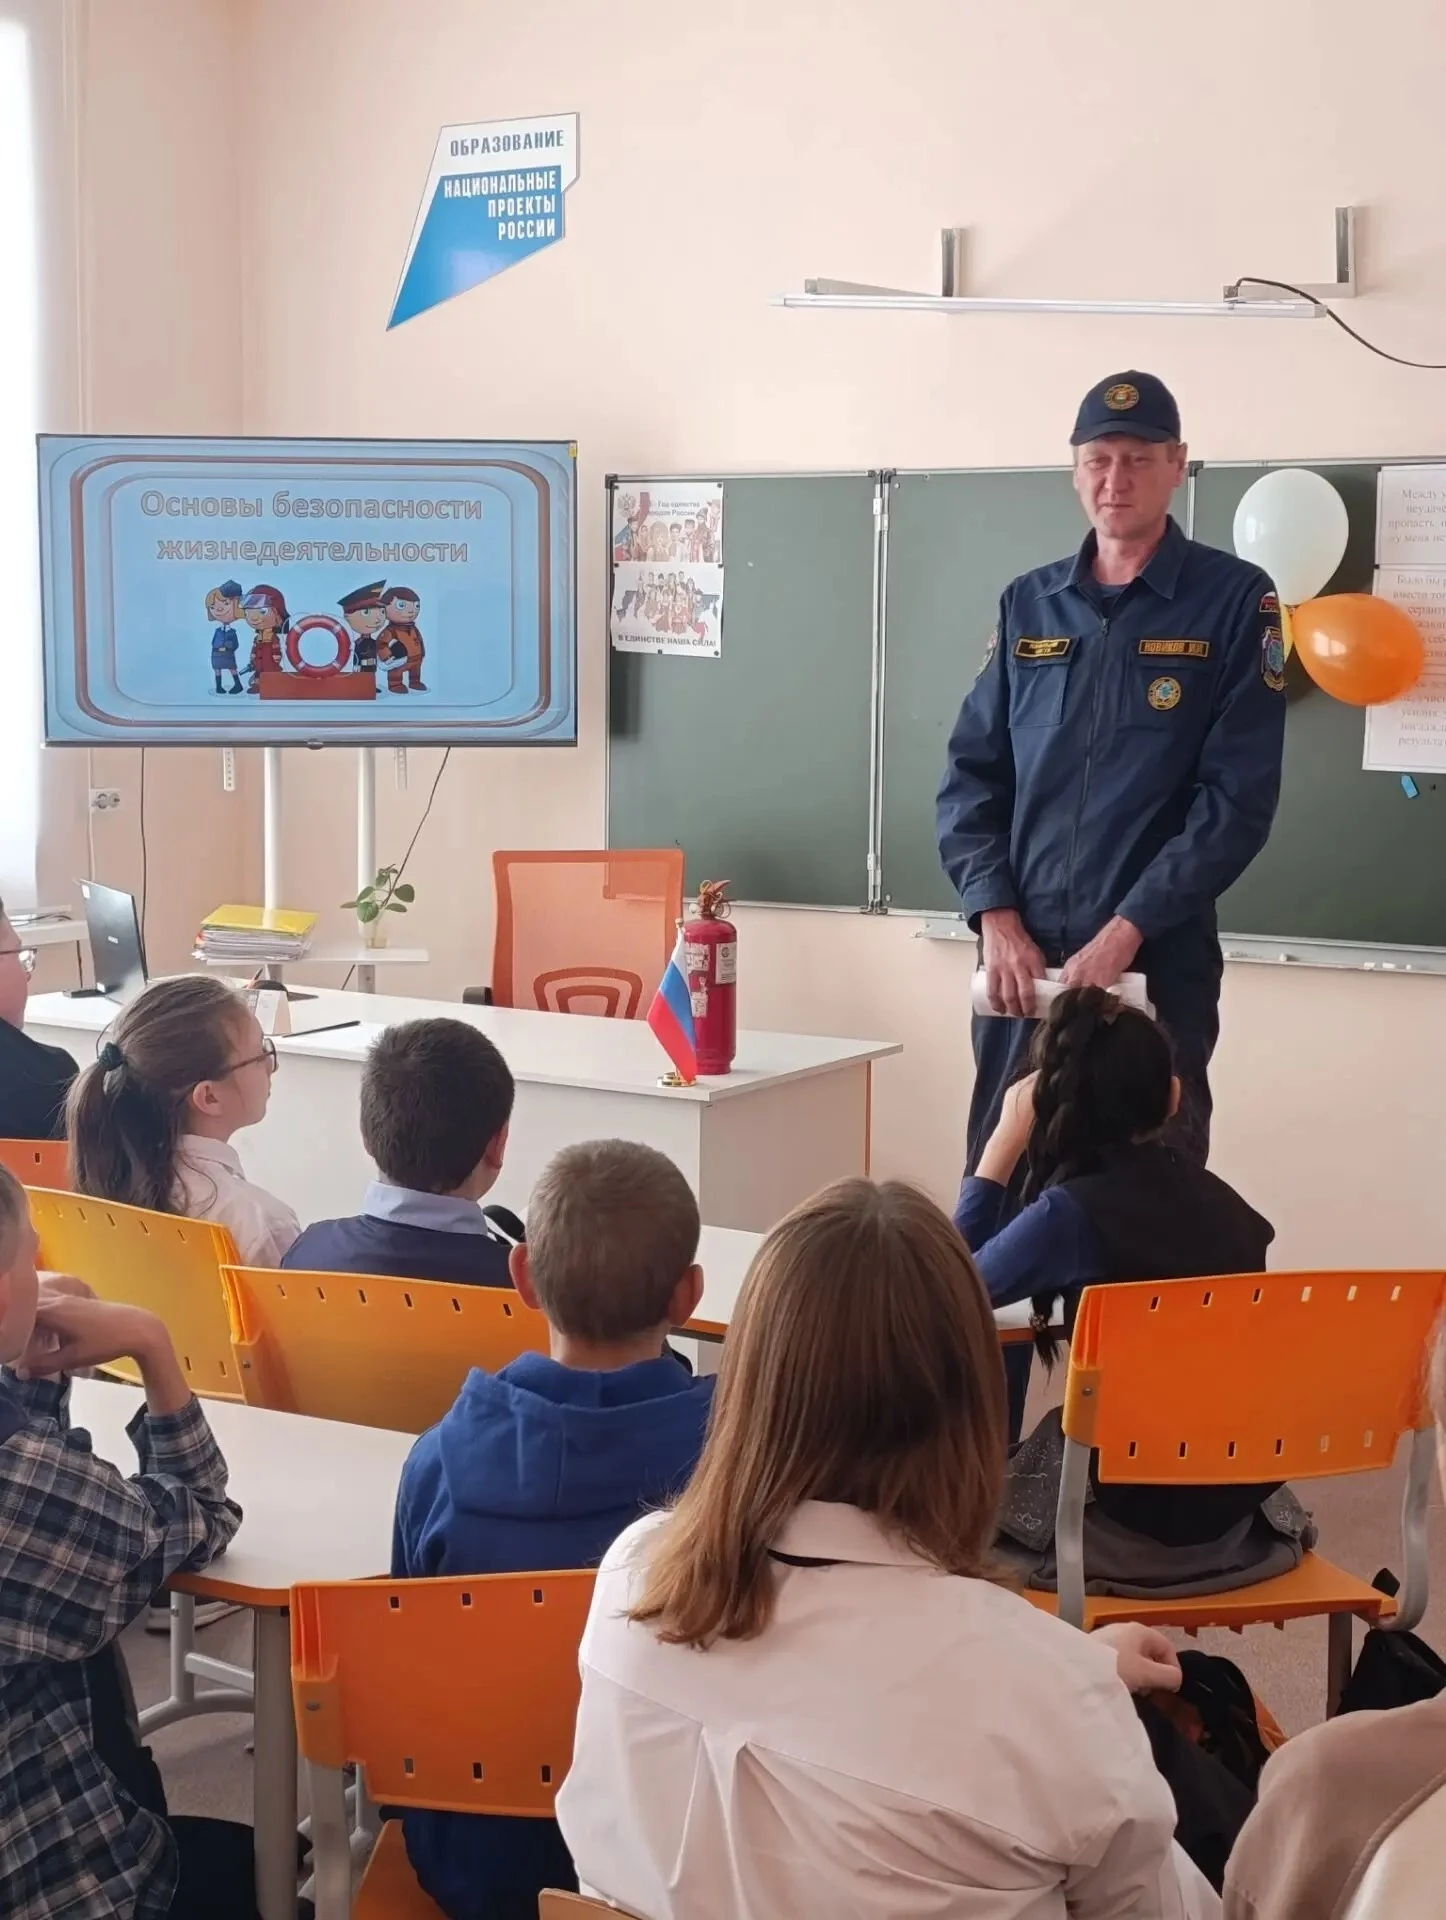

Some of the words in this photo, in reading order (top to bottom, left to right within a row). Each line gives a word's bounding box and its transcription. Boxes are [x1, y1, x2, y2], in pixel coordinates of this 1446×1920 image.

[450, 129, 565, 157] ОБРАЗОВАНИЕ
[443, 170, 557, 199] НАЦИОНАЛЬНЫЕ
[487, 194, 556, 219] ПРОЕКТЫ
[498, 217, 557, 241] РОССИИ
[139, 489, 264, 518] Основы
[271, 490, 483, 520] безопасности
[156, 539, 469, 567] жизнедеятельности
